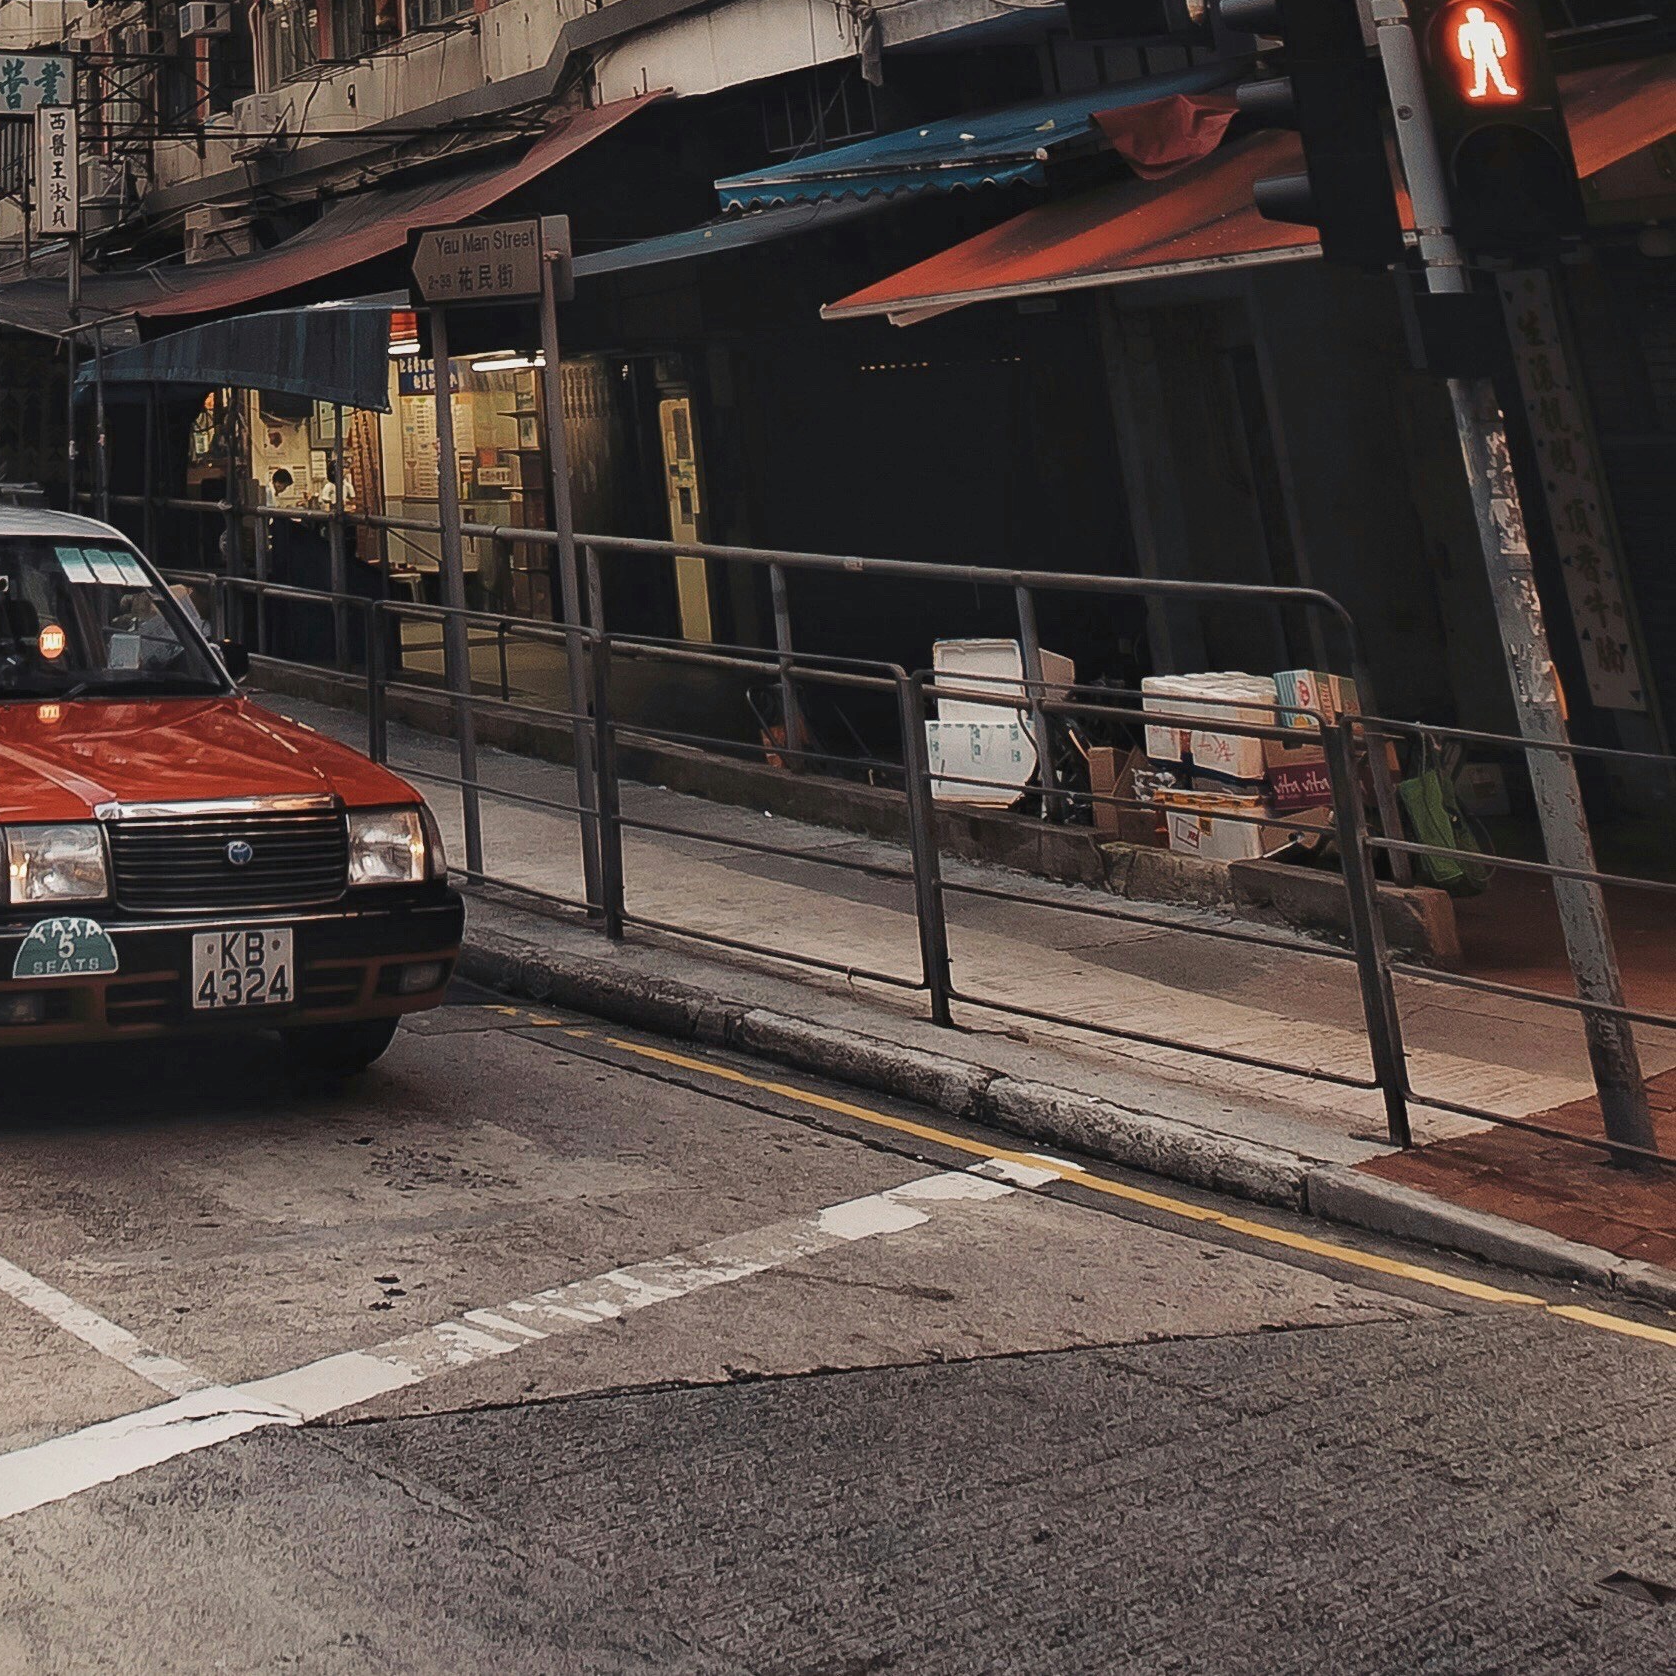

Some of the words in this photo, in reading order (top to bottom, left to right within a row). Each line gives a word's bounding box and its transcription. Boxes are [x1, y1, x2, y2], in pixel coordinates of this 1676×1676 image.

[49, 112, 71, 228] 西醫王淑貞
[435, 236, 459, 255] Yau
[462, 233, 489, 254] Man
[493, 228, 535, 250] Street
[457, 264, 514, 293] 祐民街
[58, 934, 74, 958] 5
[220, 931, 265, 969] KB
[32, 957, 100, 974] SEATS
[197, 964, 289, 1007] 4324
